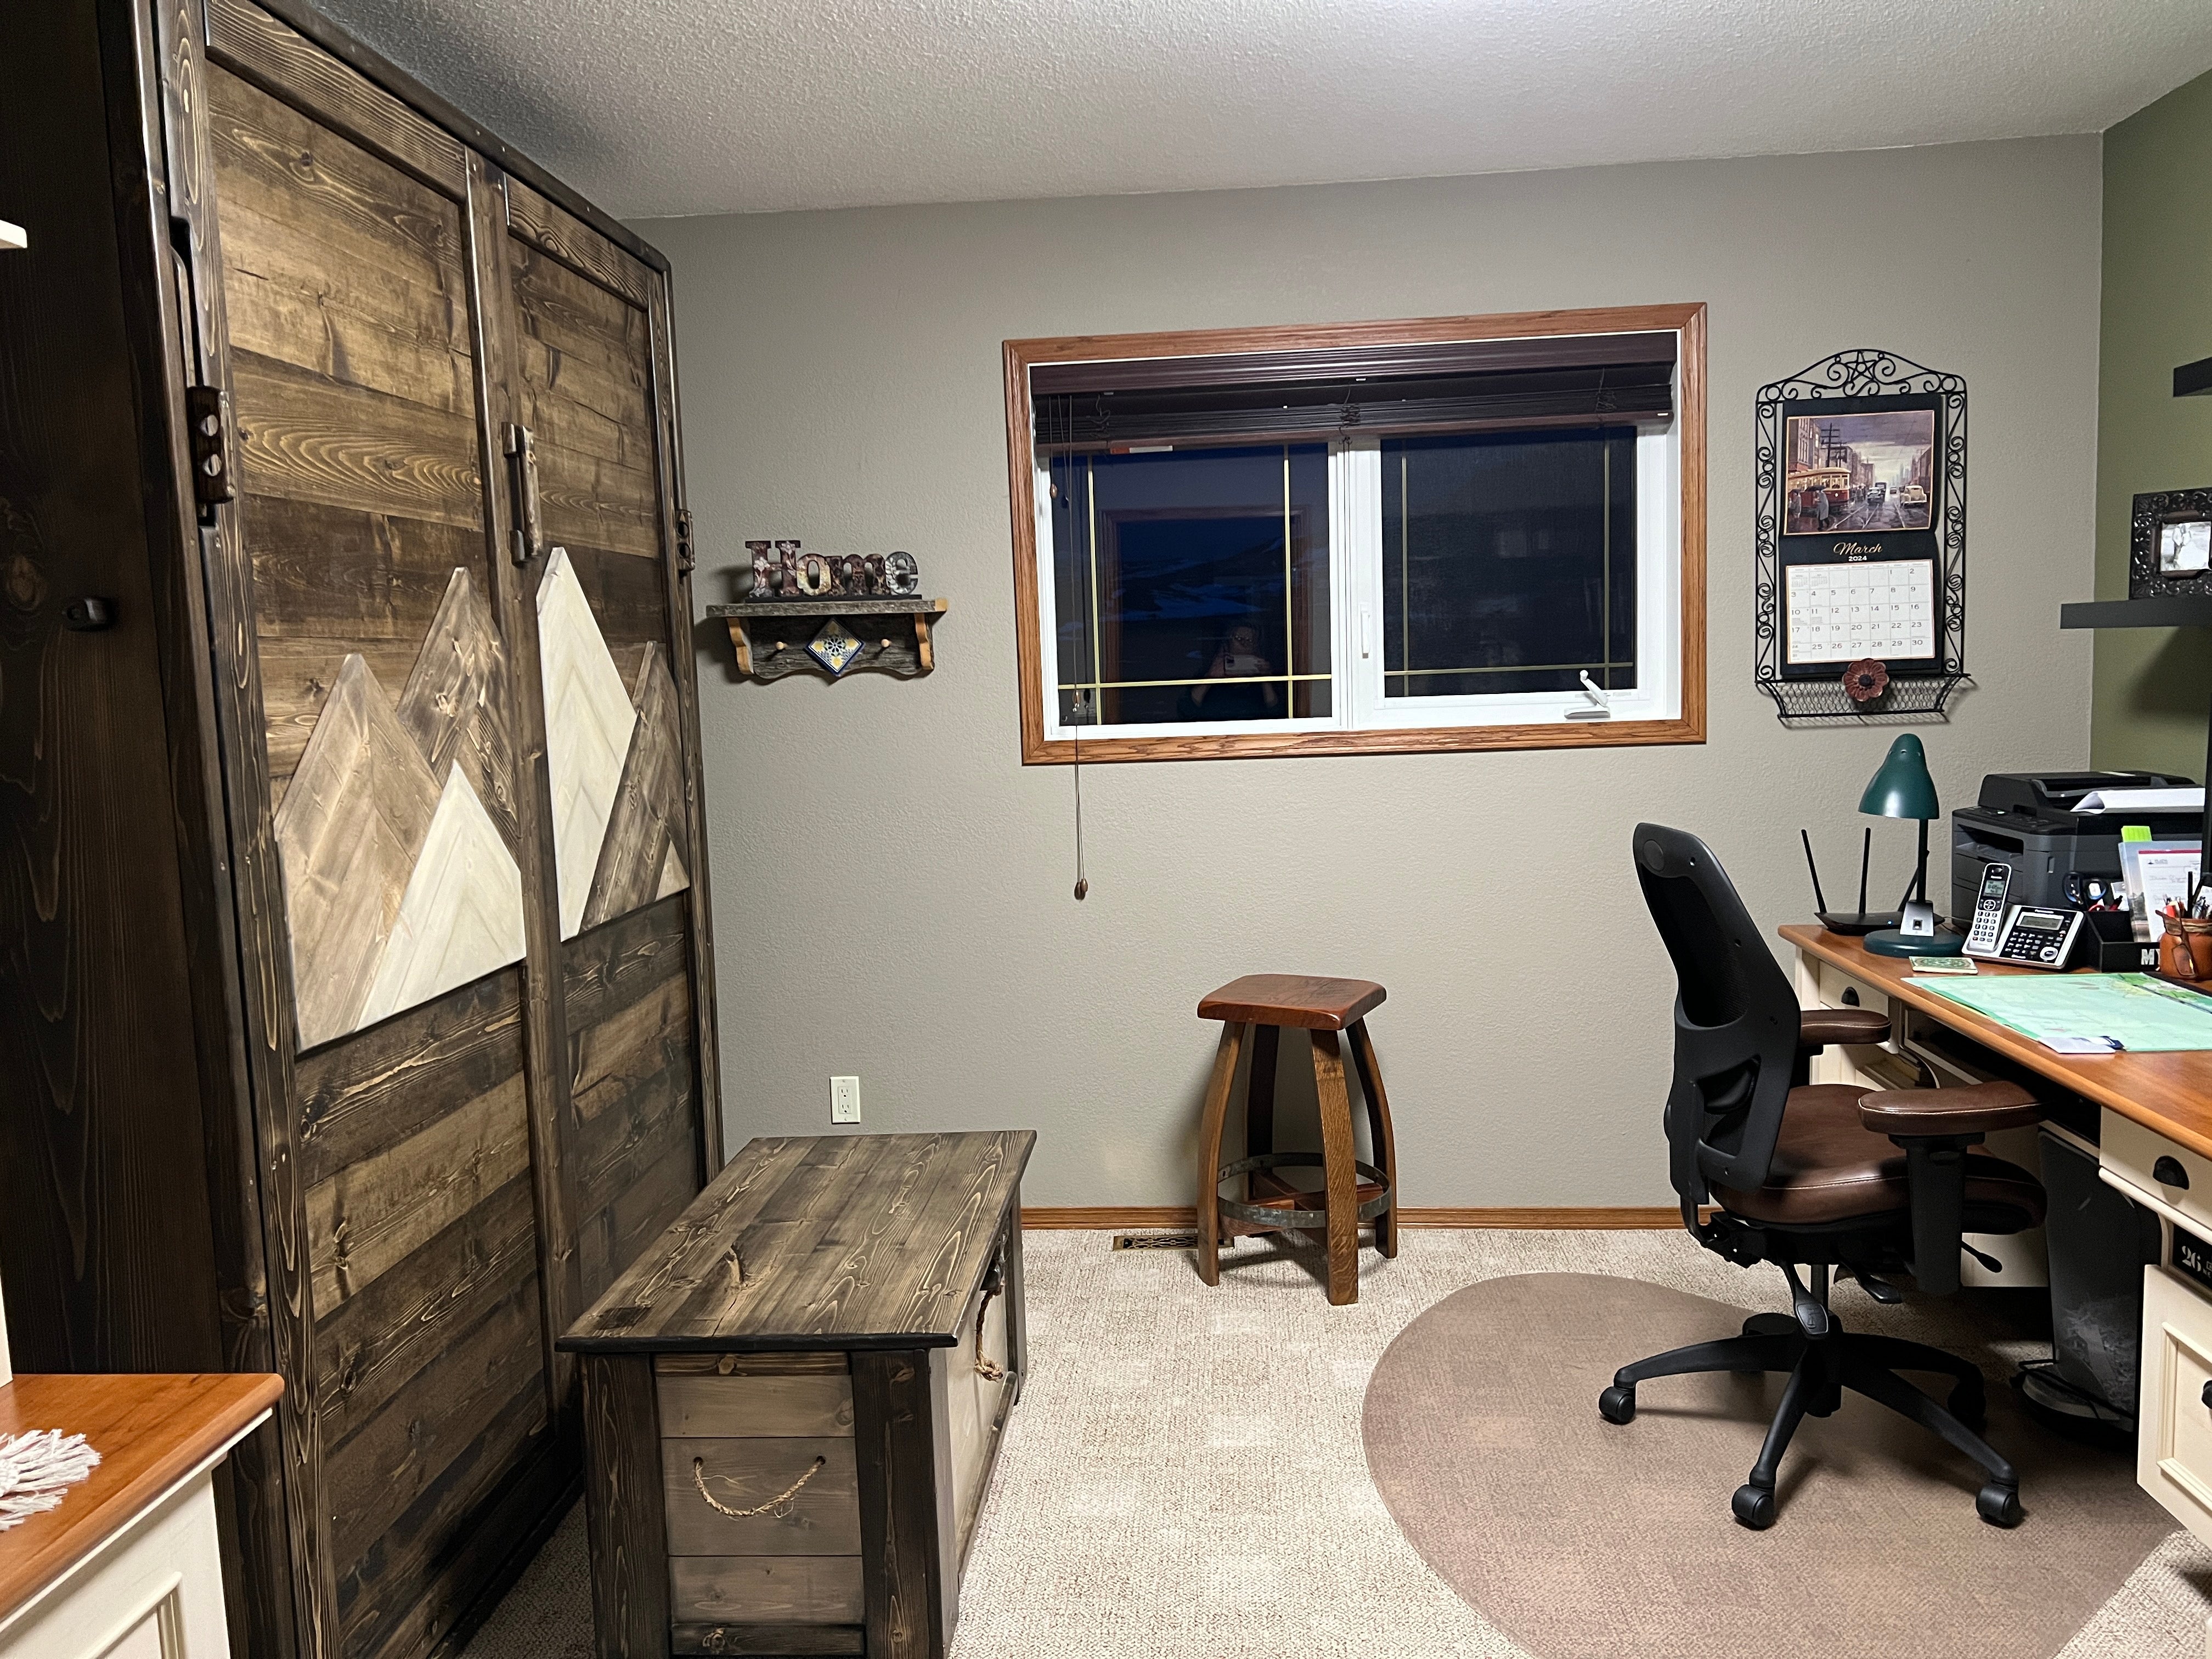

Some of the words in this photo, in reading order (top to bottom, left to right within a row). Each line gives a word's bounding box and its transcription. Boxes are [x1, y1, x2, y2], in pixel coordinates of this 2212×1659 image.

[1833, 542, 1883, 555] March
[745, 540, 918, 597] Home
[2181, 1245, 2202, 1272] 26
